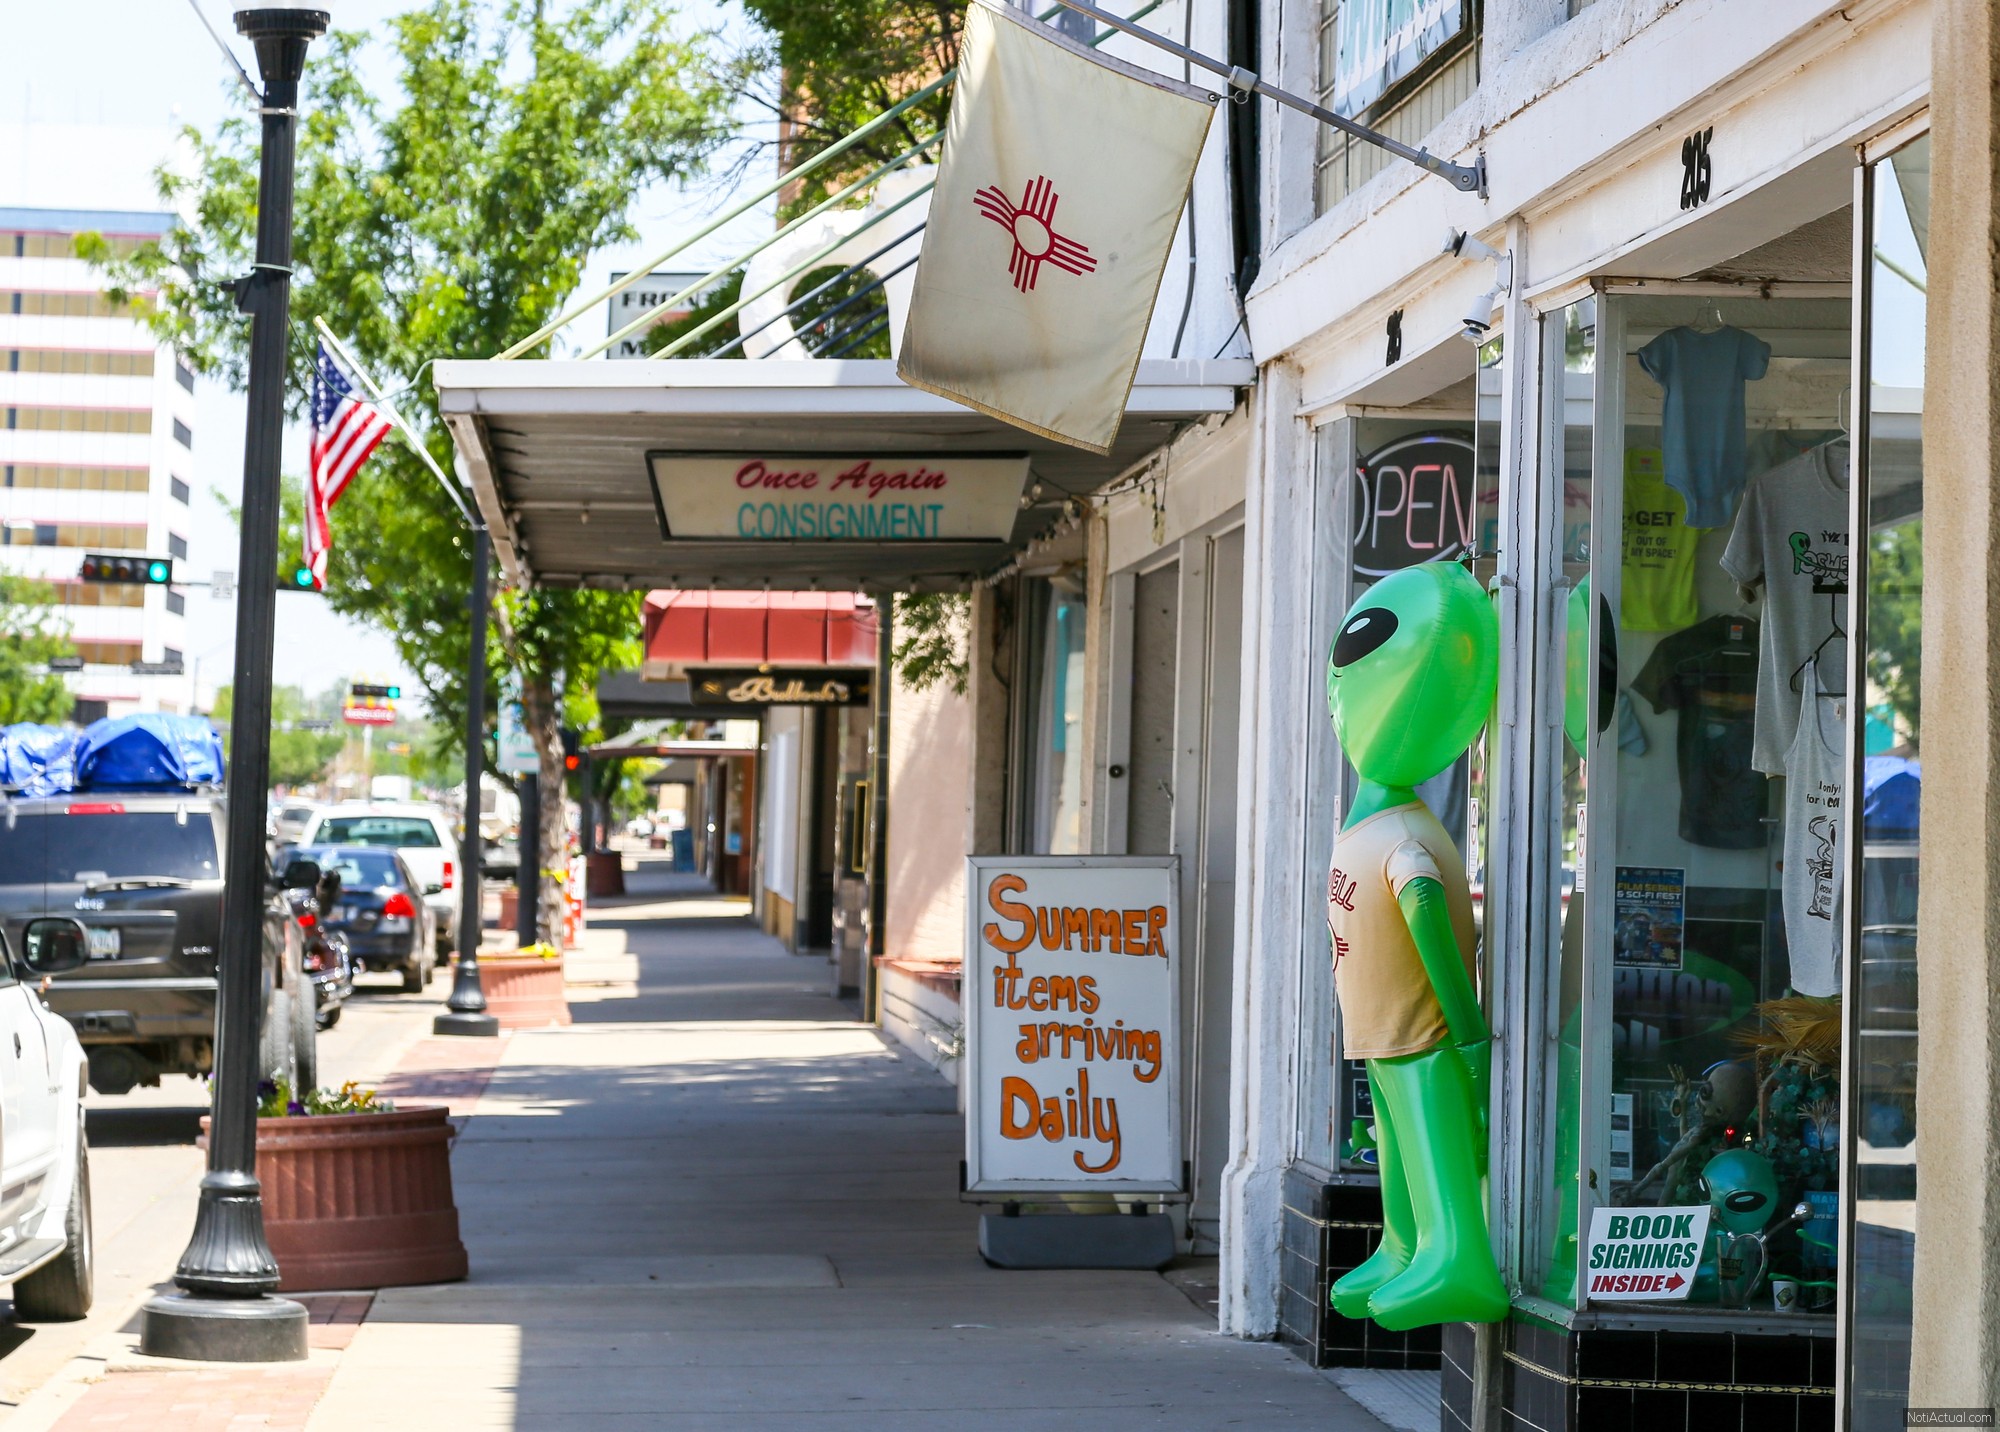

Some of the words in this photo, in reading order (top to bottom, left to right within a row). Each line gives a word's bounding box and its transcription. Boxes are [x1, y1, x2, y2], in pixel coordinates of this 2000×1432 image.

[1680, 125, 1713, 210] 205
[736, 459, 819, 490] Once
[828, 461, 948, 499] Again
[737, 502, 945, 540] CONSIGNMENT
[1635, 510, 1676, 527] GET
[1636, 536, 1654, 546] OUT
[1656, 537, 1668, 546] OF
[1616, 882, 1643, 891] FILM
[1645, 884, 1682, 892] SERIES
[1616, 890, 1625, 898] &
[1626, 891, 1655, 899] SCI-FI
[1656, 892, 1682, 900] FEST
[74, 897, 106, 912] Jeep
[993, 953, 1101, 1015] items
[1015, 1018, 1162, 1084] arriving
[999, 1067, 1121, 1174] Daily
[1607, 1214, 1695, 1240] BOOK
[1589, 1242, 1698, 1270] SIGNINGS
[1590, 1274, 1665, 1293] INSIDE
